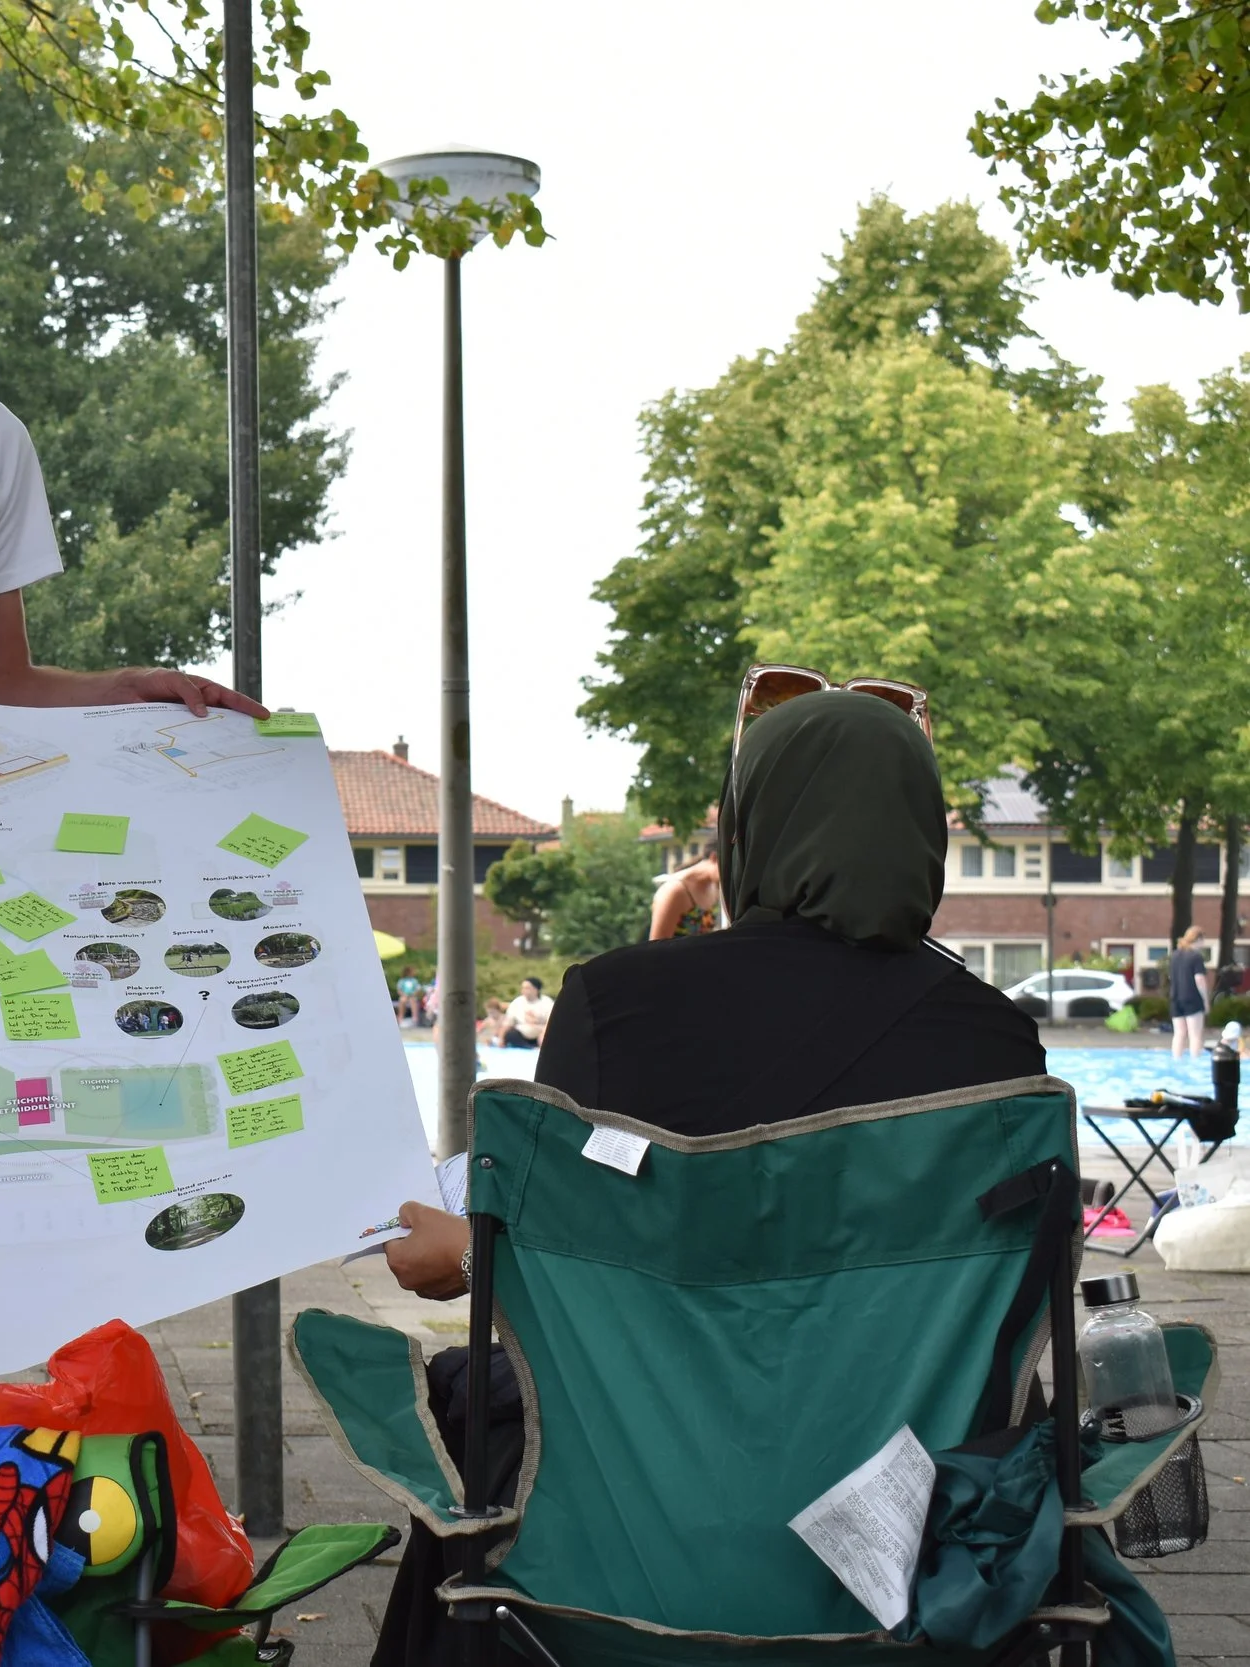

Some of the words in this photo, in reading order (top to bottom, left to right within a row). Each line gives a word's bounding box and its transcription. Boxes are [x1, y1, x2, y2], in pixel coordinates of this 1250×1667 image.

[202, 874, 243, 882] Natuurlijke
[244, 874, 265, 882] vijver
[117, 879, 156, 887] voetenpad
[262, 923, 297, 931] Moestuin
[103, 932, 139, 941] speeltuin
[172, 929, 208, 937] Sportveld
[226, 972, 292, 986] Waterzuiverende
[237, 980, 279, 990] beplanting
[125, 989, 160, 997] jongeren
[198, 990, 211, 1001] ?
[6, 1095, 59, 1106] STICHTING
[11, 1101, 77, 1113] MIDDELPUNT
[197, 1177, 221, 1187] onder
